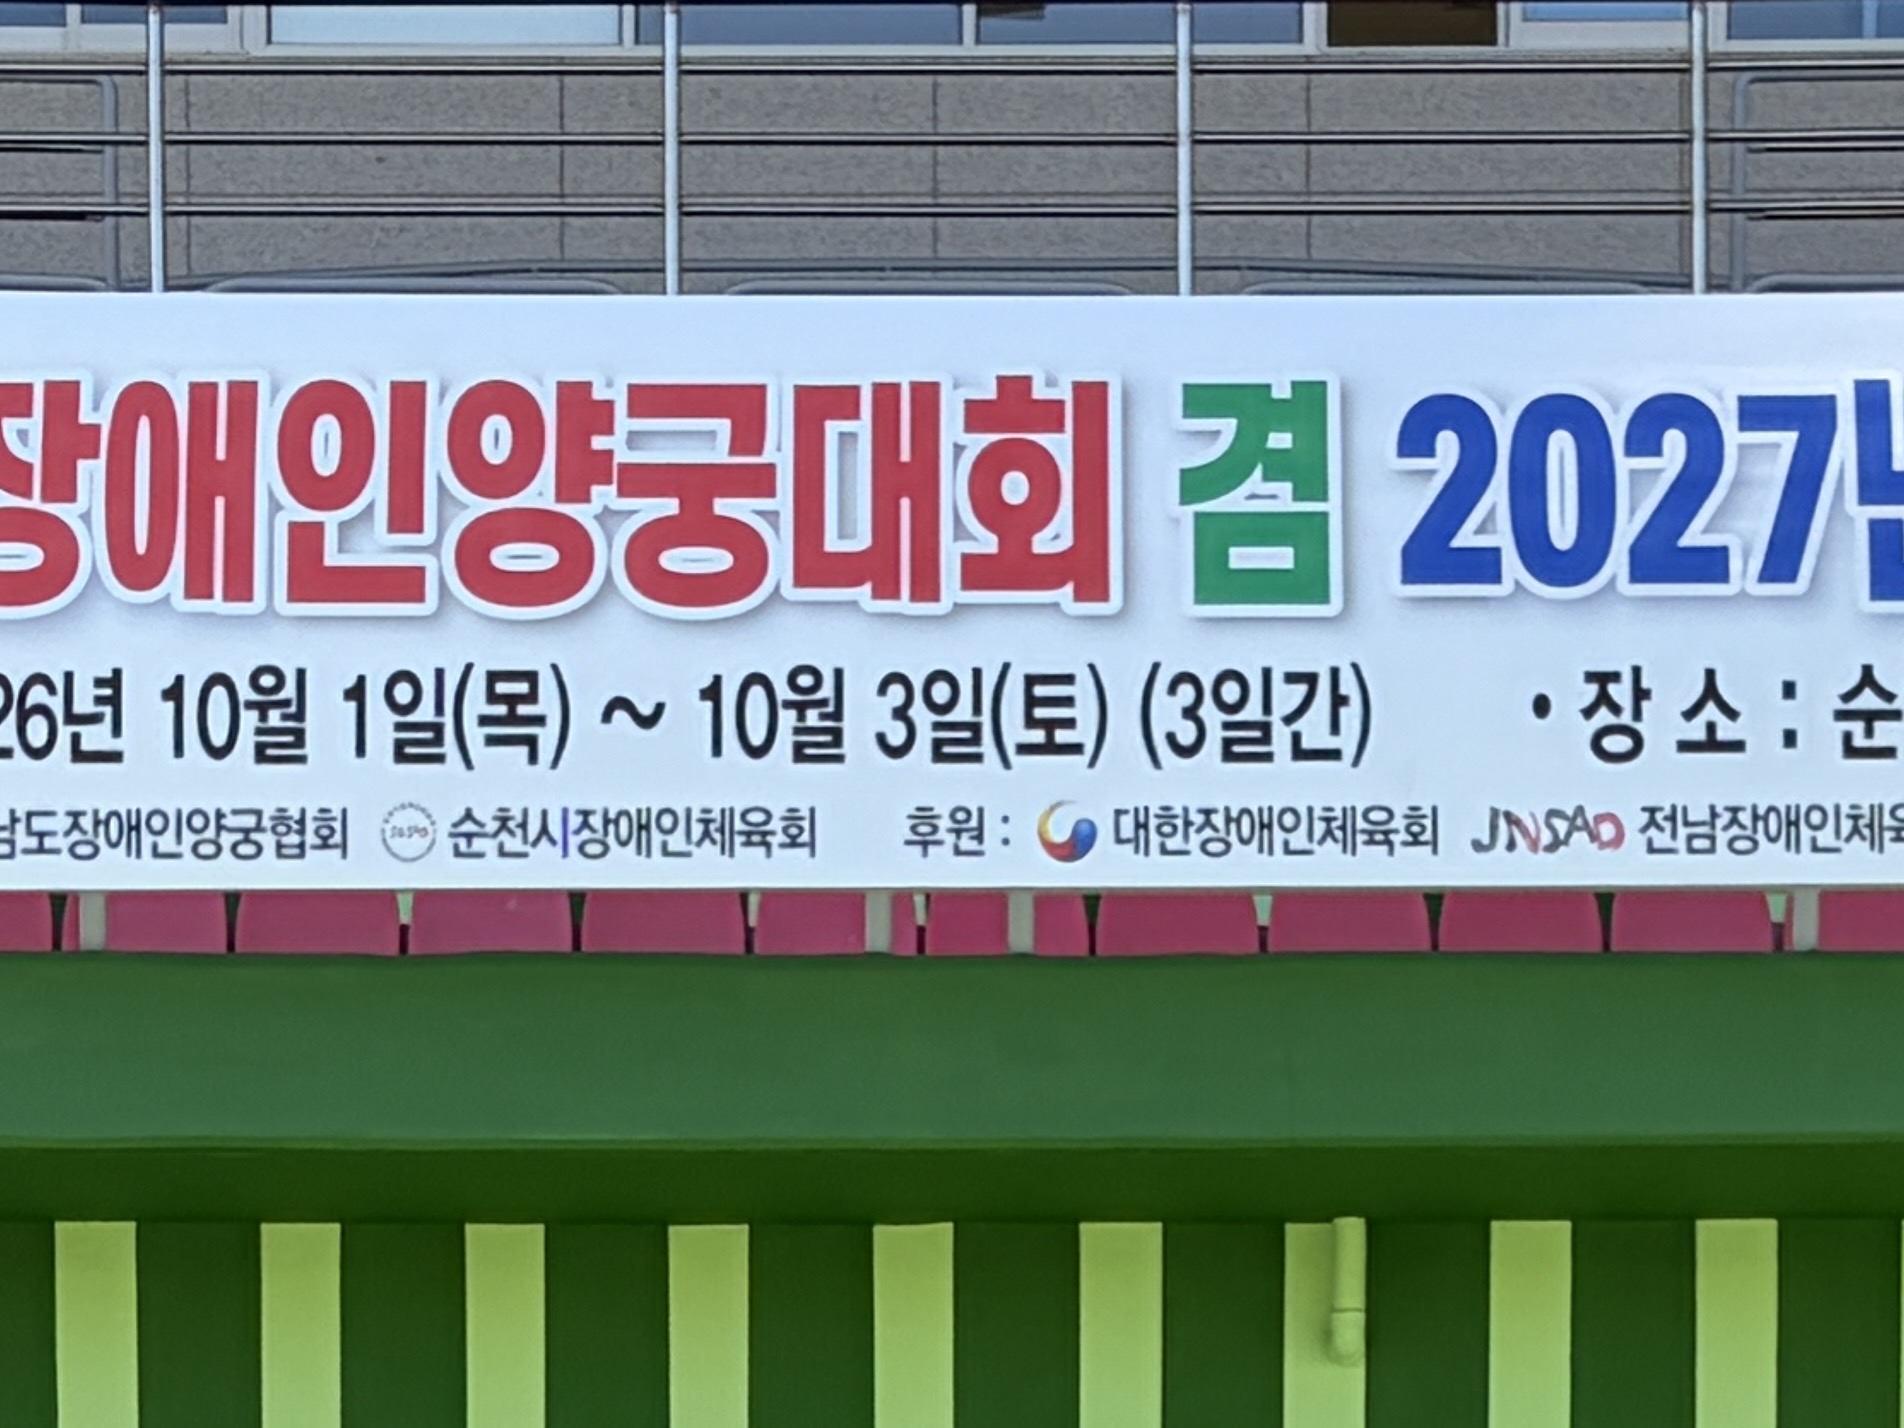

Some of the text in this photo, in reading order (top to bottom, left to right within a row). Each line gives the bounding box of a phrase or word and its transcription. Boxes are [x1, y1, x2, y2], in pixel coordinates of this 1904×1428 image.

[1179, 380, 1331, 605] 겸
[161, 664, 308, 765] 10월
[343, 662, 570, 771] 1일(목)
[698, 664, 846, 764] 10월
[875, 661, 1108, 771] 3일(토)
[1140, 661, 1371, 770] (3일간)
[447, 806, 816, 860] 순천시장애인체육회
[903, 805, 985, 858] 후원
[1113, 804, 1439, 858] 대한장애인체육회
